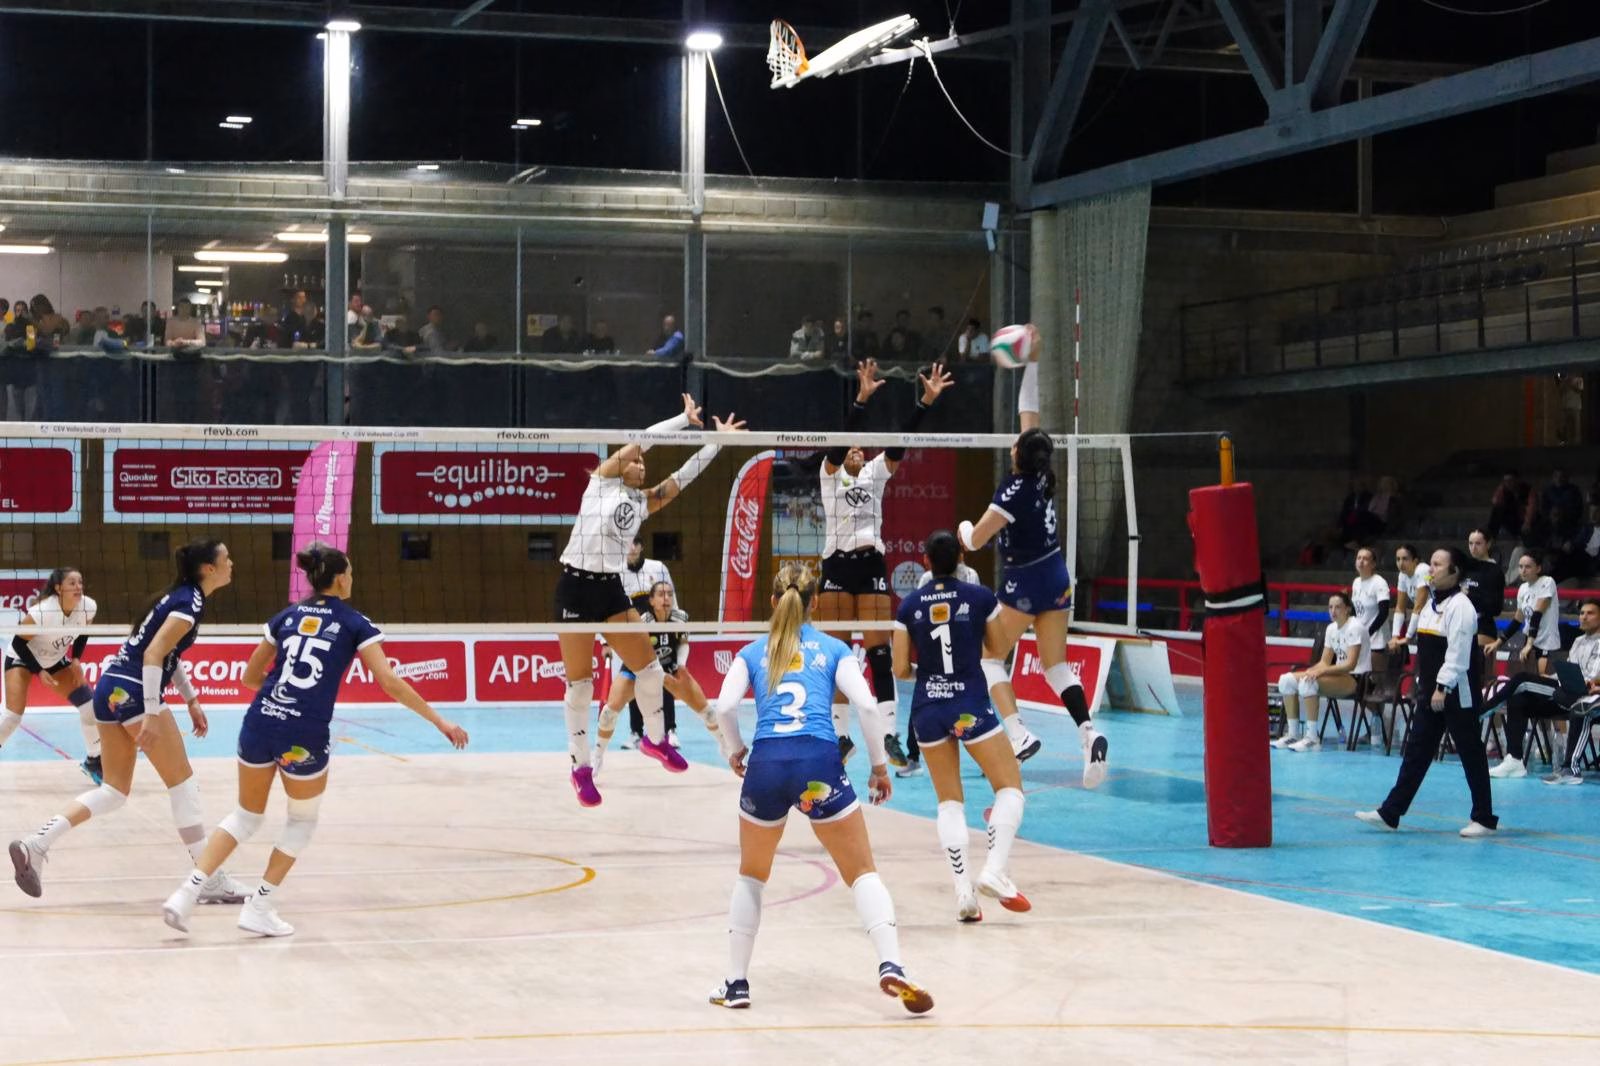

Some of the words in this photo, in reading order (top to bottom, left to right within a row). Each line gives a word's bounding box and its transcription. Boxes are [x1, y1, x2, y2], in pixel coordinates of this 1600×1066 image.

[203, 426, 258, 436] rfevb.com
[497, 431, 550, 440] rfevb.com
[776, 434, 827, 442] rfevb.com
[215, 468, 278, 487] Rotger
[872, 576, 887, 591] 16
[920, 590, 958, 602] MARTÍNEZ
[297, 605, 333, 615] FORTUNA
[930, 624, 954, 674] 1
[278, 635, 332, 689] 15
[488, 654, 548, 684] APP
[202, 686, 239, 696] Menorca
[926, 680, 965, 693] Esports
[772, 681, 808, 734] 3
